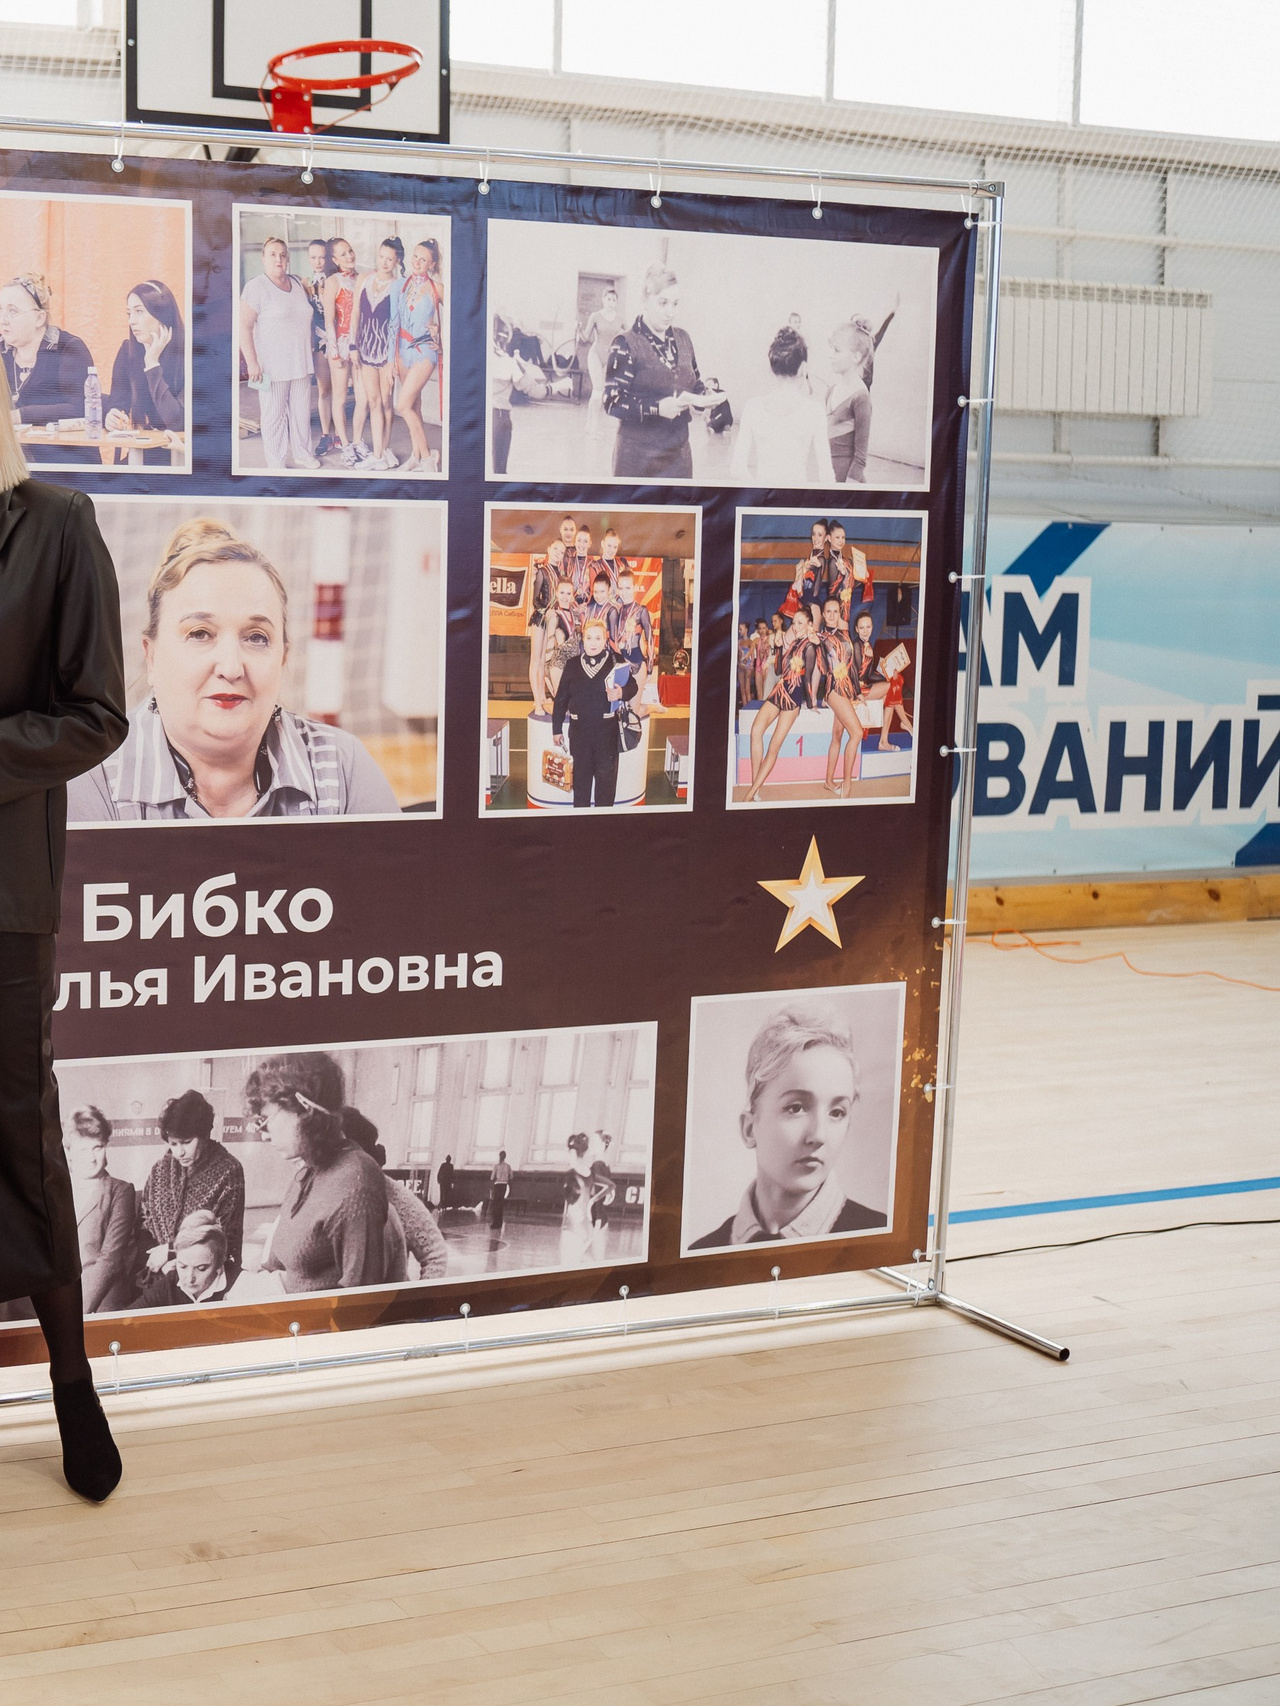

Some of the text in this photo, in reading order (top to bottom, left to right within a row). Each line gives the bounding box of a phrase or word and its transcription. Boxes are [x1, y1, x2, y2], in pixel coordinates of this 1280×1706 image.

[795, 735, 804, 757] 1
[952, 694, 1280, 818] ВАНИЙ
[82, 872, 334, 942] Бибко
[193, 949, 504, 1004] Ивановна
